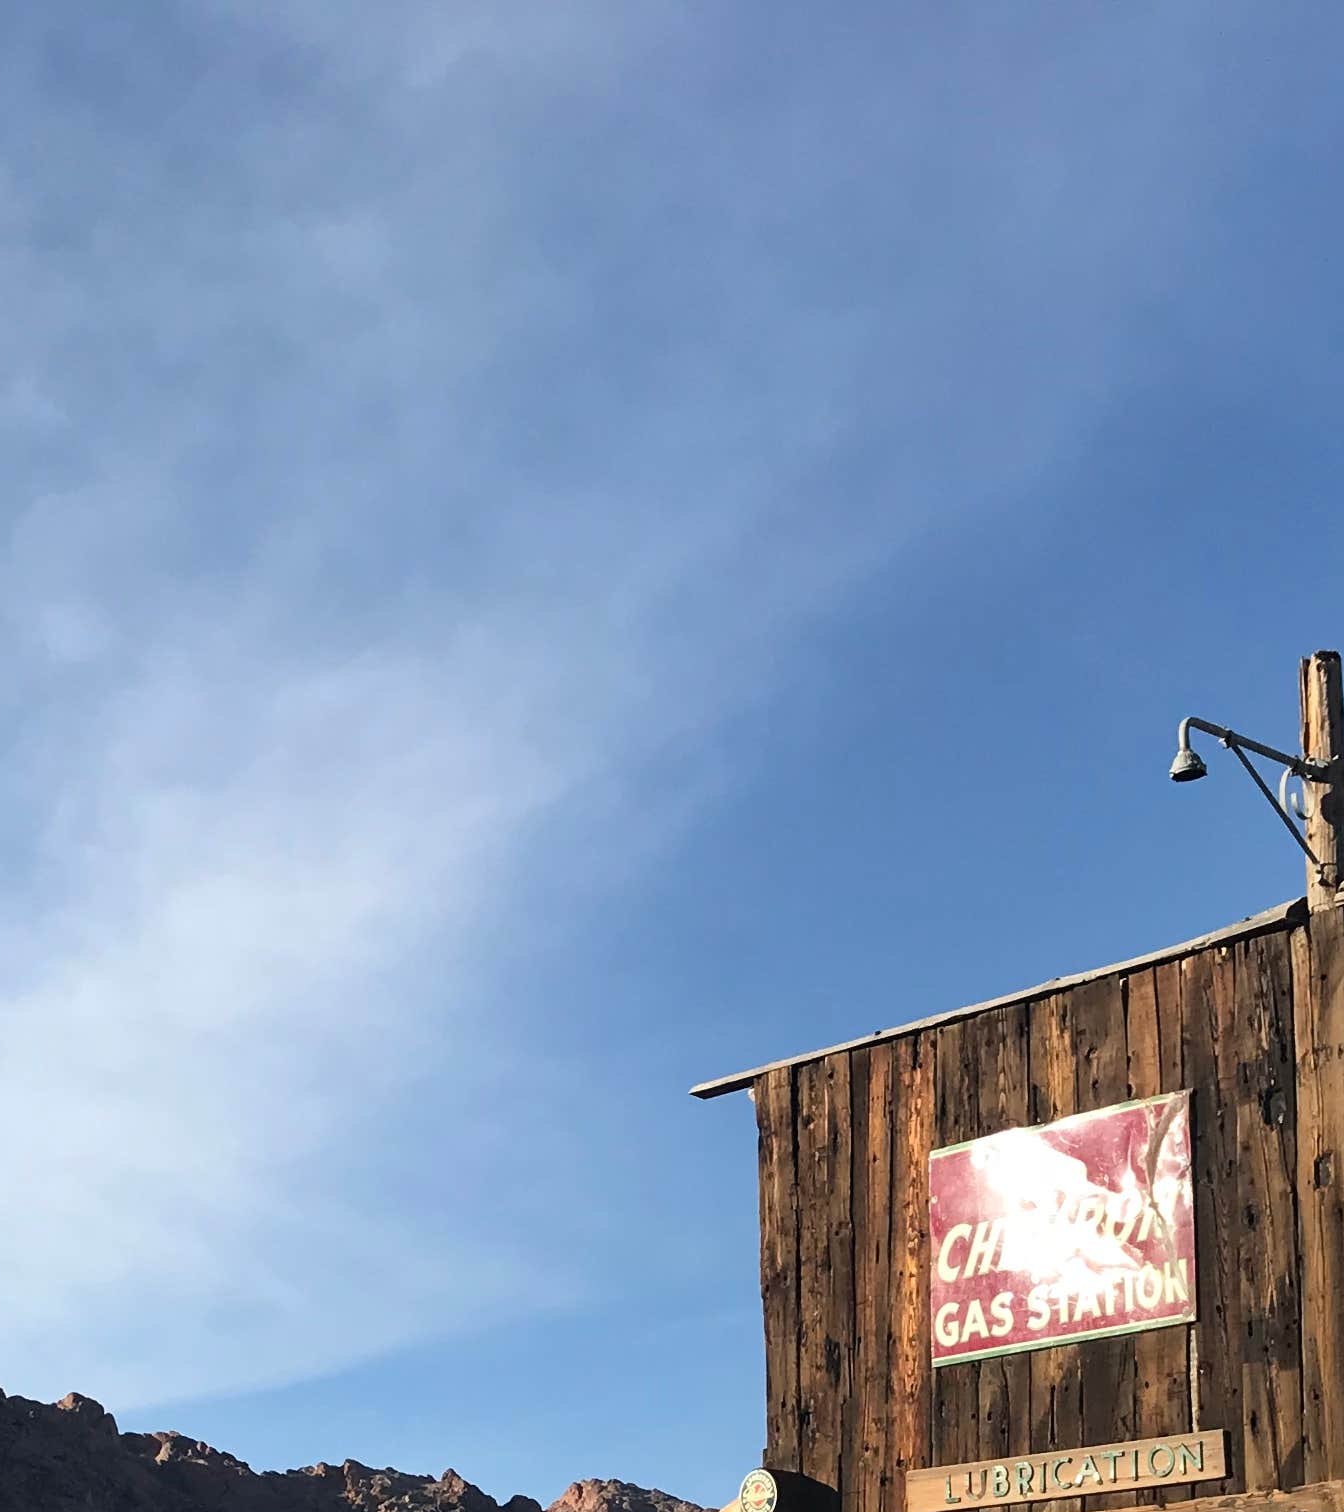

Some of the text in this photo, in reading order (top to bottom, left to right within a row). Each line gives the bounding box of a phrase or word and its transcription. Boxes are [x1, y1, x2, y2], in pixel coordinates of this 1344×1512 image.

[937, 1180, 1178, 1283] CHRON
[935, 1258, 1189, 1347] GAS STATION
[945, 1440, 1205, 1505] LUBRICATION
